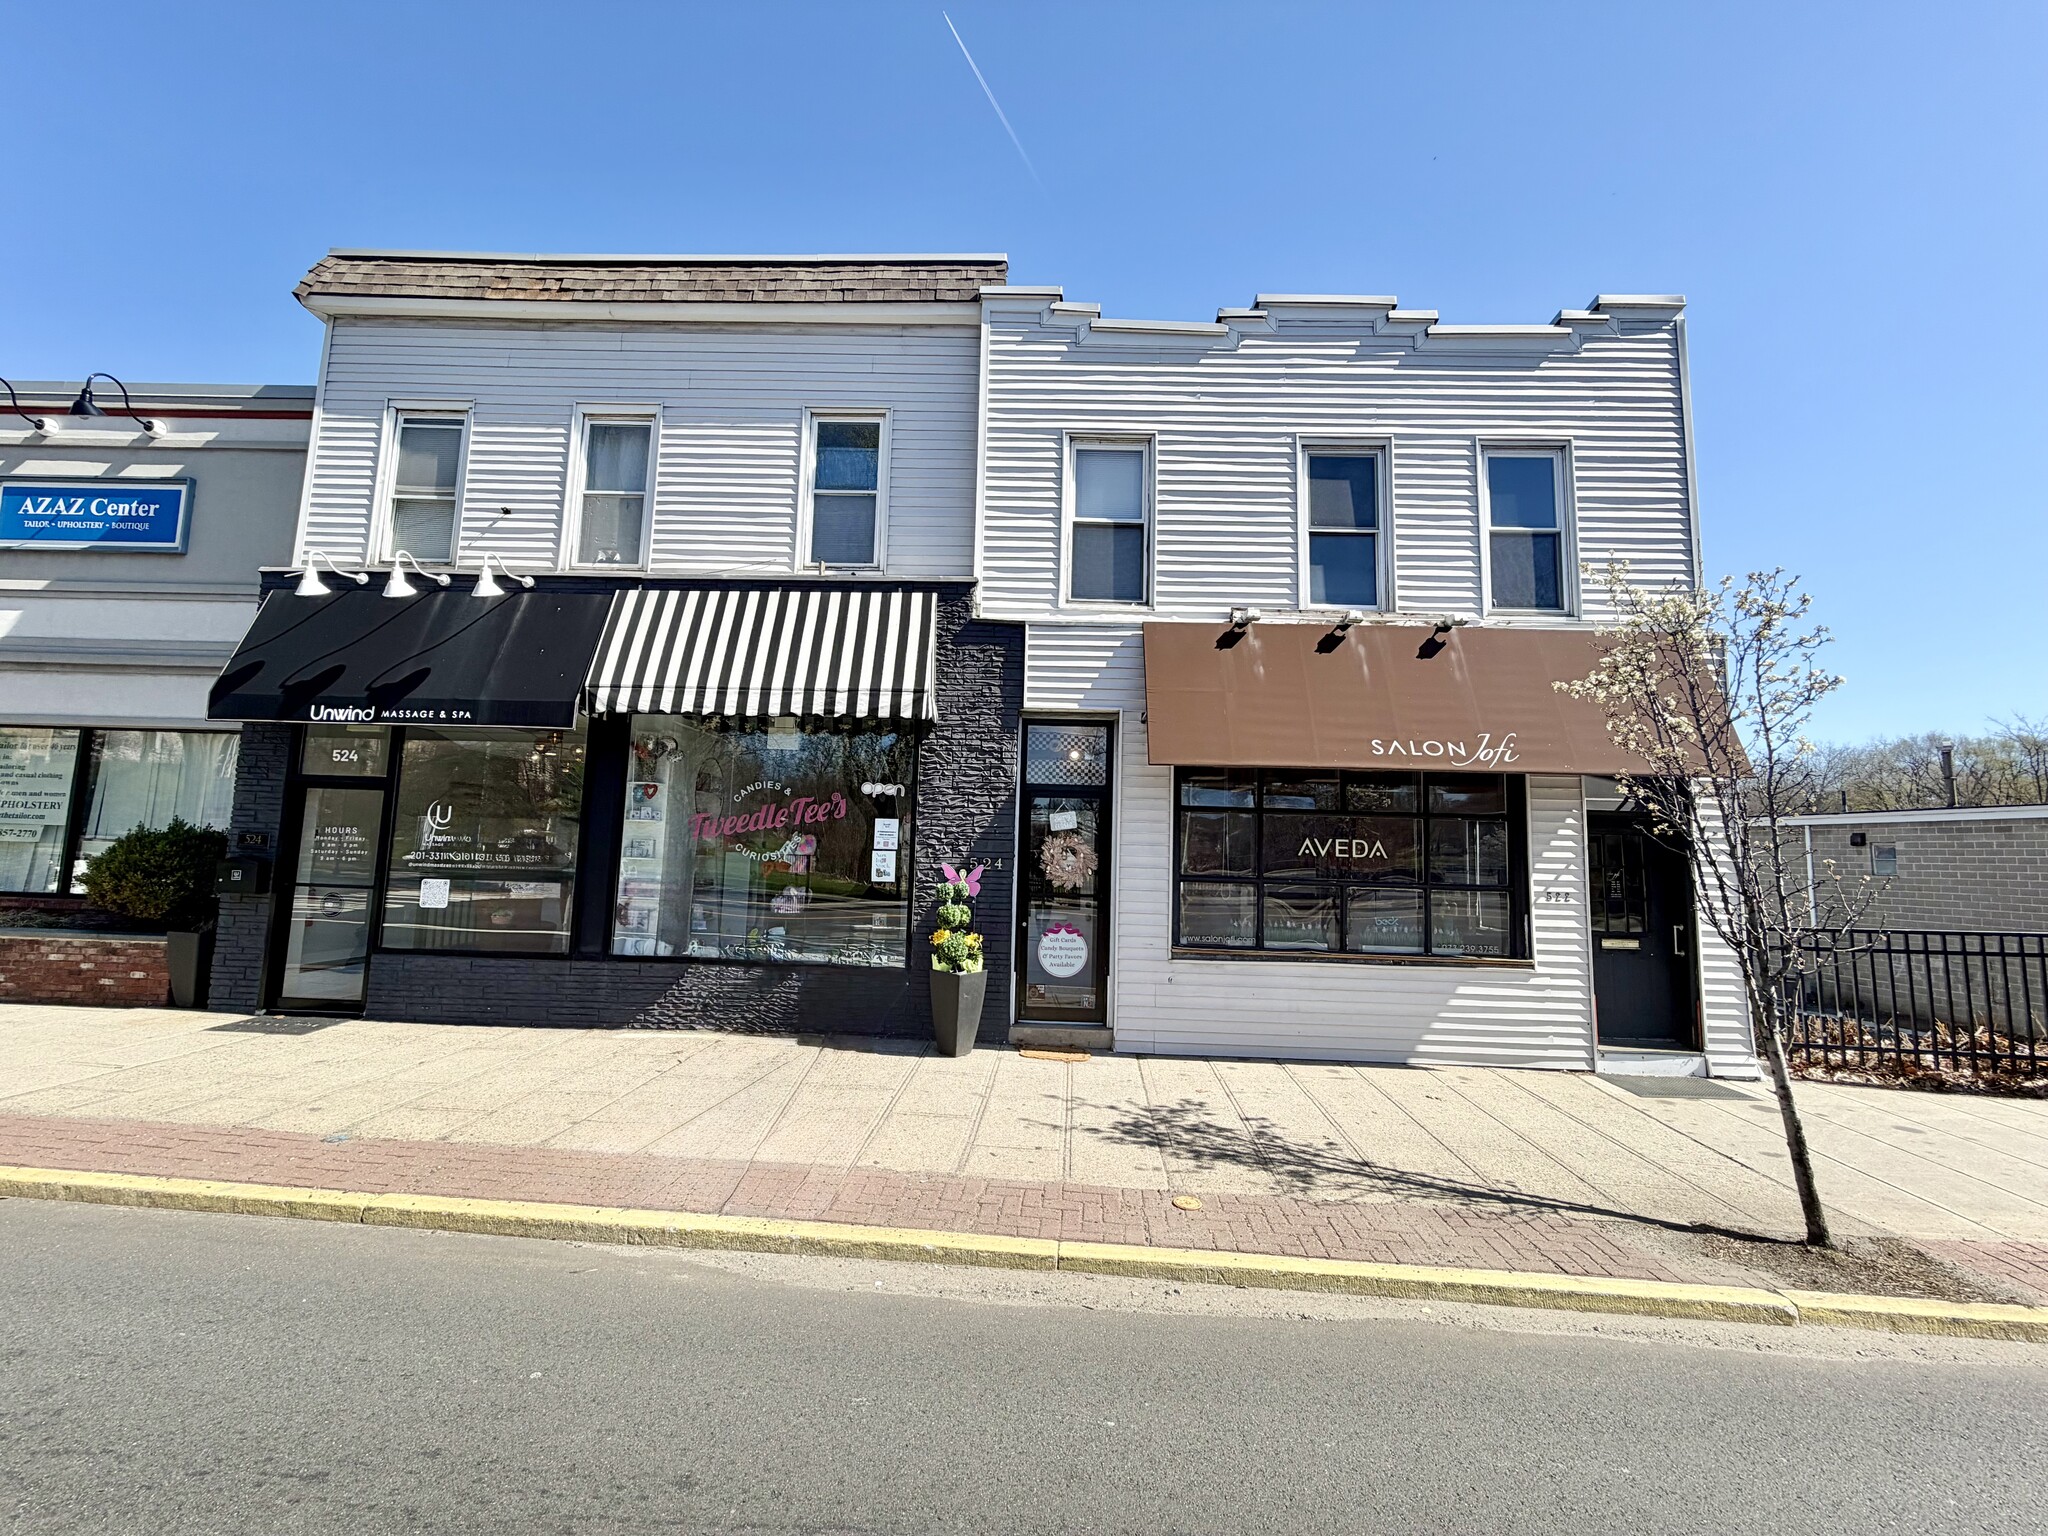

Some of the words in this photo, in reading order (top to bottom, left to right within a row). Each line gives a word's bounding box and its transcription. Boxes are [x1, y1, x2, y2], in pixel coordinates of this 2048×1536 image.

[18, 497, 85, 515] AZAZ
[90, 498, 160, 517] Center
[24, 520, 50, 528] TAILOR
[57, 521, 104, 529] UPHOLSTERY
[111, 522, 150, 531] BOUTIQUE
[310, 705, 375, 721] Unwind
[381, 710, 434, 718] MASSAGE
[452, 711, 471, 719] SPA
[0, 741, 18, 750] ailor
[1371, 739, 1466, 757] SALON
[332, 750, 358, 762] 524
[733, 781, 781, 802] CANDIES
[784, 787, 792, 797] &
[861, 782, 905, 798] open
[0, 800, 63, 809] PHOLSTERY
[325, 826, 358, 834] HOURS
[244, 834, 262, 844] 524
[736, 835, 802, 861] CURIOSITIES
[1298, 838, 1388, 859] AVEDA
[970, 857, 1003, 869] 524
[1545, 892, 1570, 902] 522
